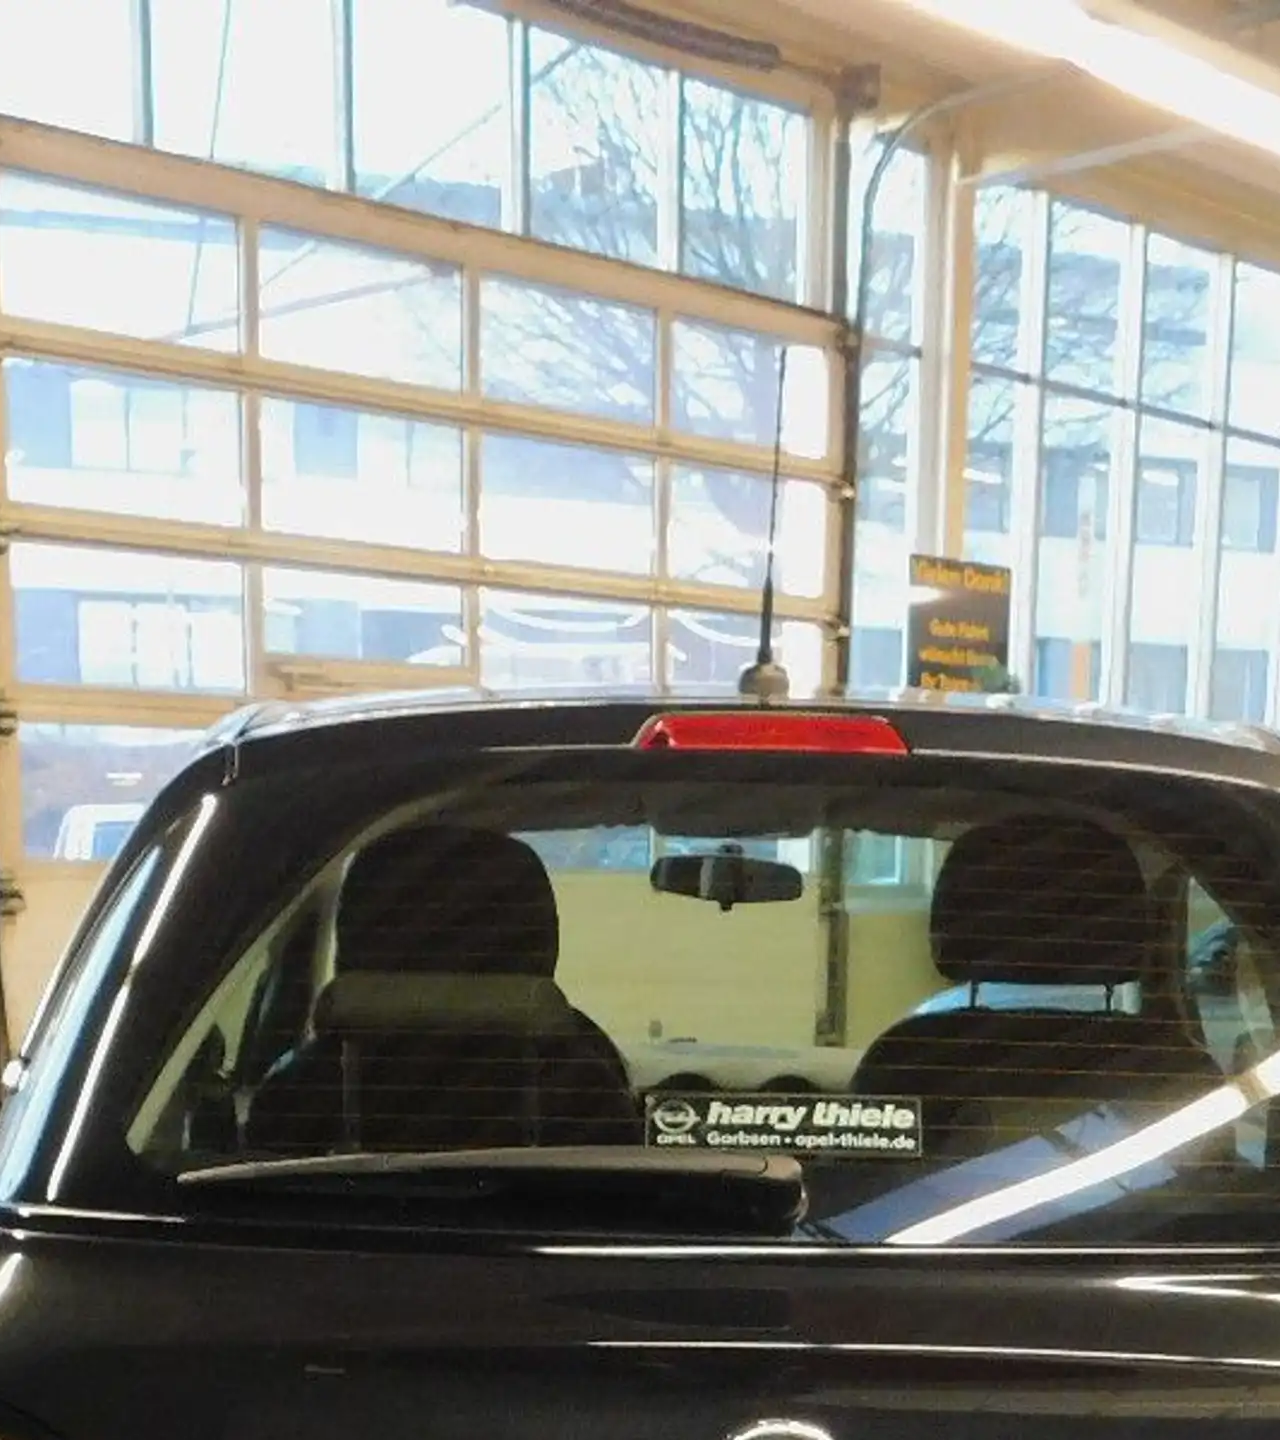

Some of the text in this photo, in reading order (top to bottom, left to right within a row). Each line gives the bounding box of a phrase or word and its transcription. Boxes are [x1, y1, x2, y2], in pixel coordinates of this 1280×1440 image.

[706, 1101, 915, 1131] harry thiele
[656, 1133, 696, 1145] OPEL
[707, 1131, 915, 1149] Garbsen opel-thiele.de
